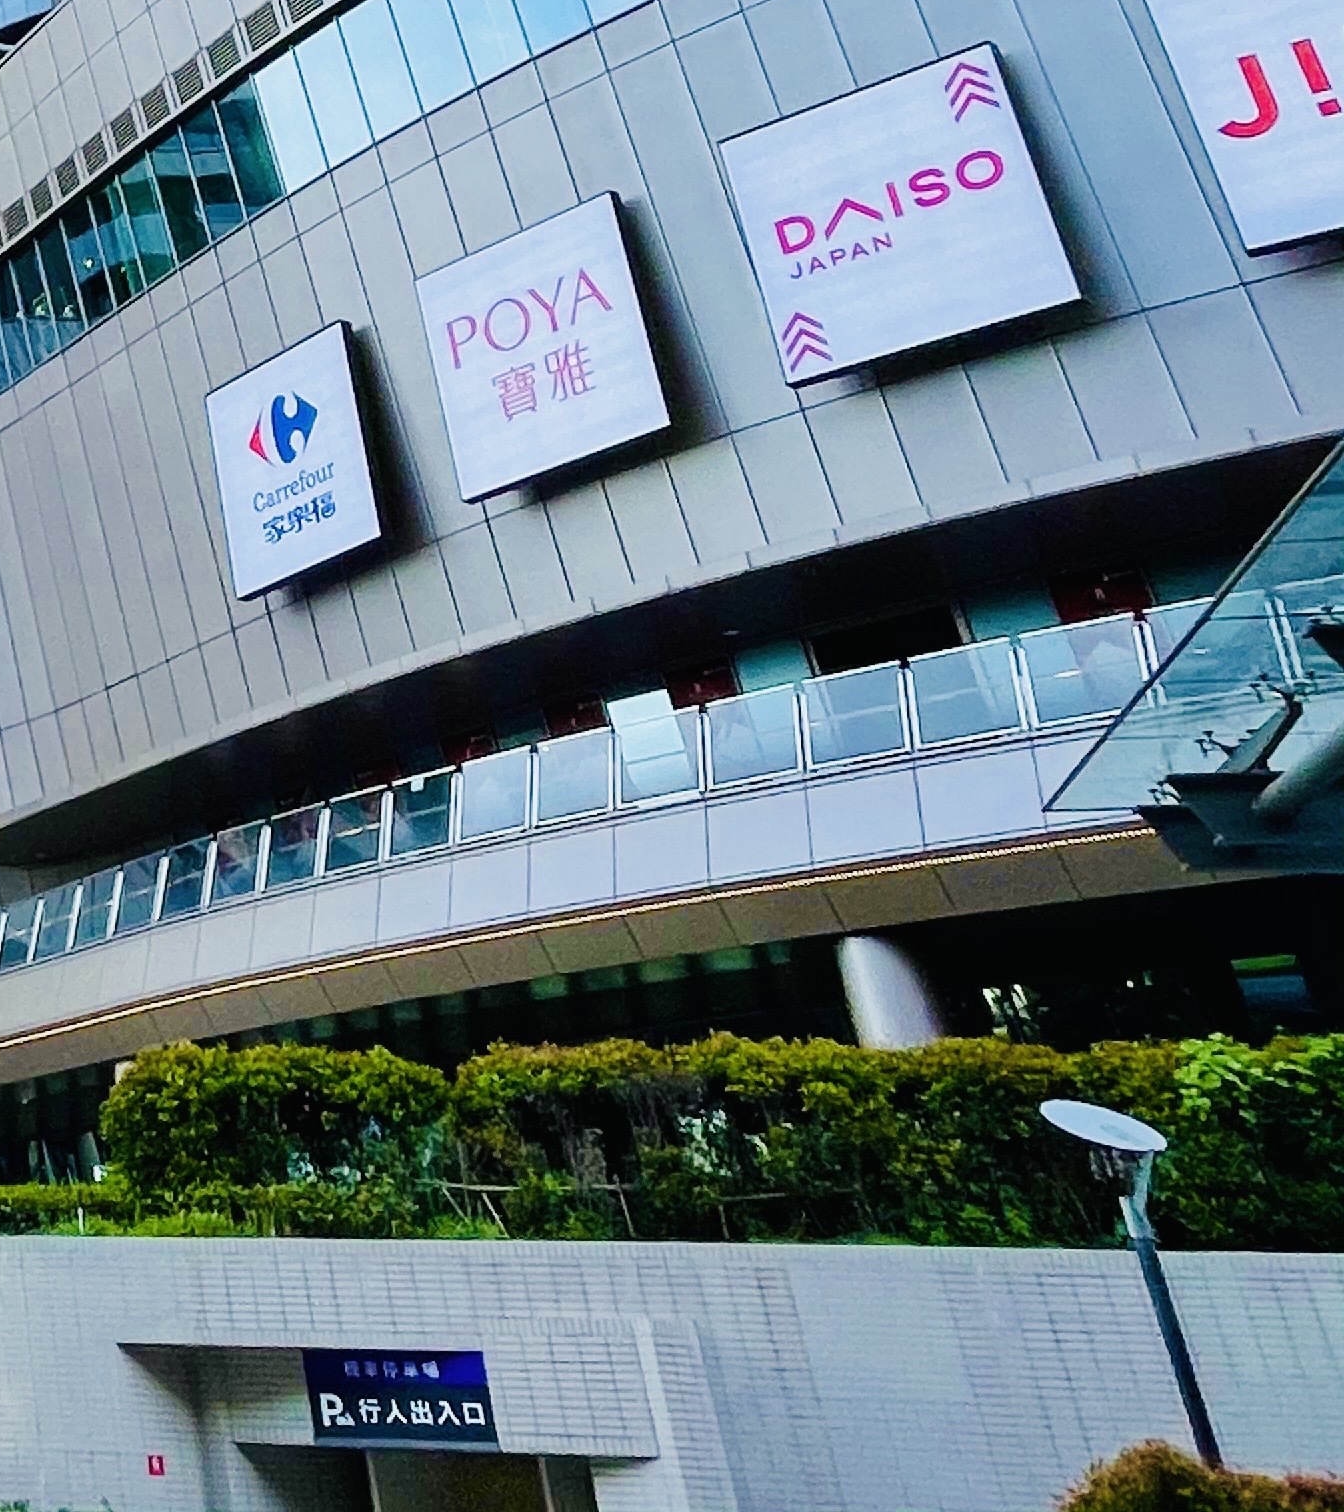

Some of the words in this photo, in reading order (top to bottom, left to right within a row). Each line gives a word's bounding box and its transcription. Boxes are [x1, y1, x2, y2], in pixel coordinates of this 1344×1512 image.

[774, 149, 1004, 256] DAISO
[789, 232, 895, 280] JAPAN
[445, 266, 614, 369] POYA
[490, 338, 598, 422] 寶雅
[252, 462, 335, 513] Carrefour
[358, 1397, 486, 1426] 行人出入口
